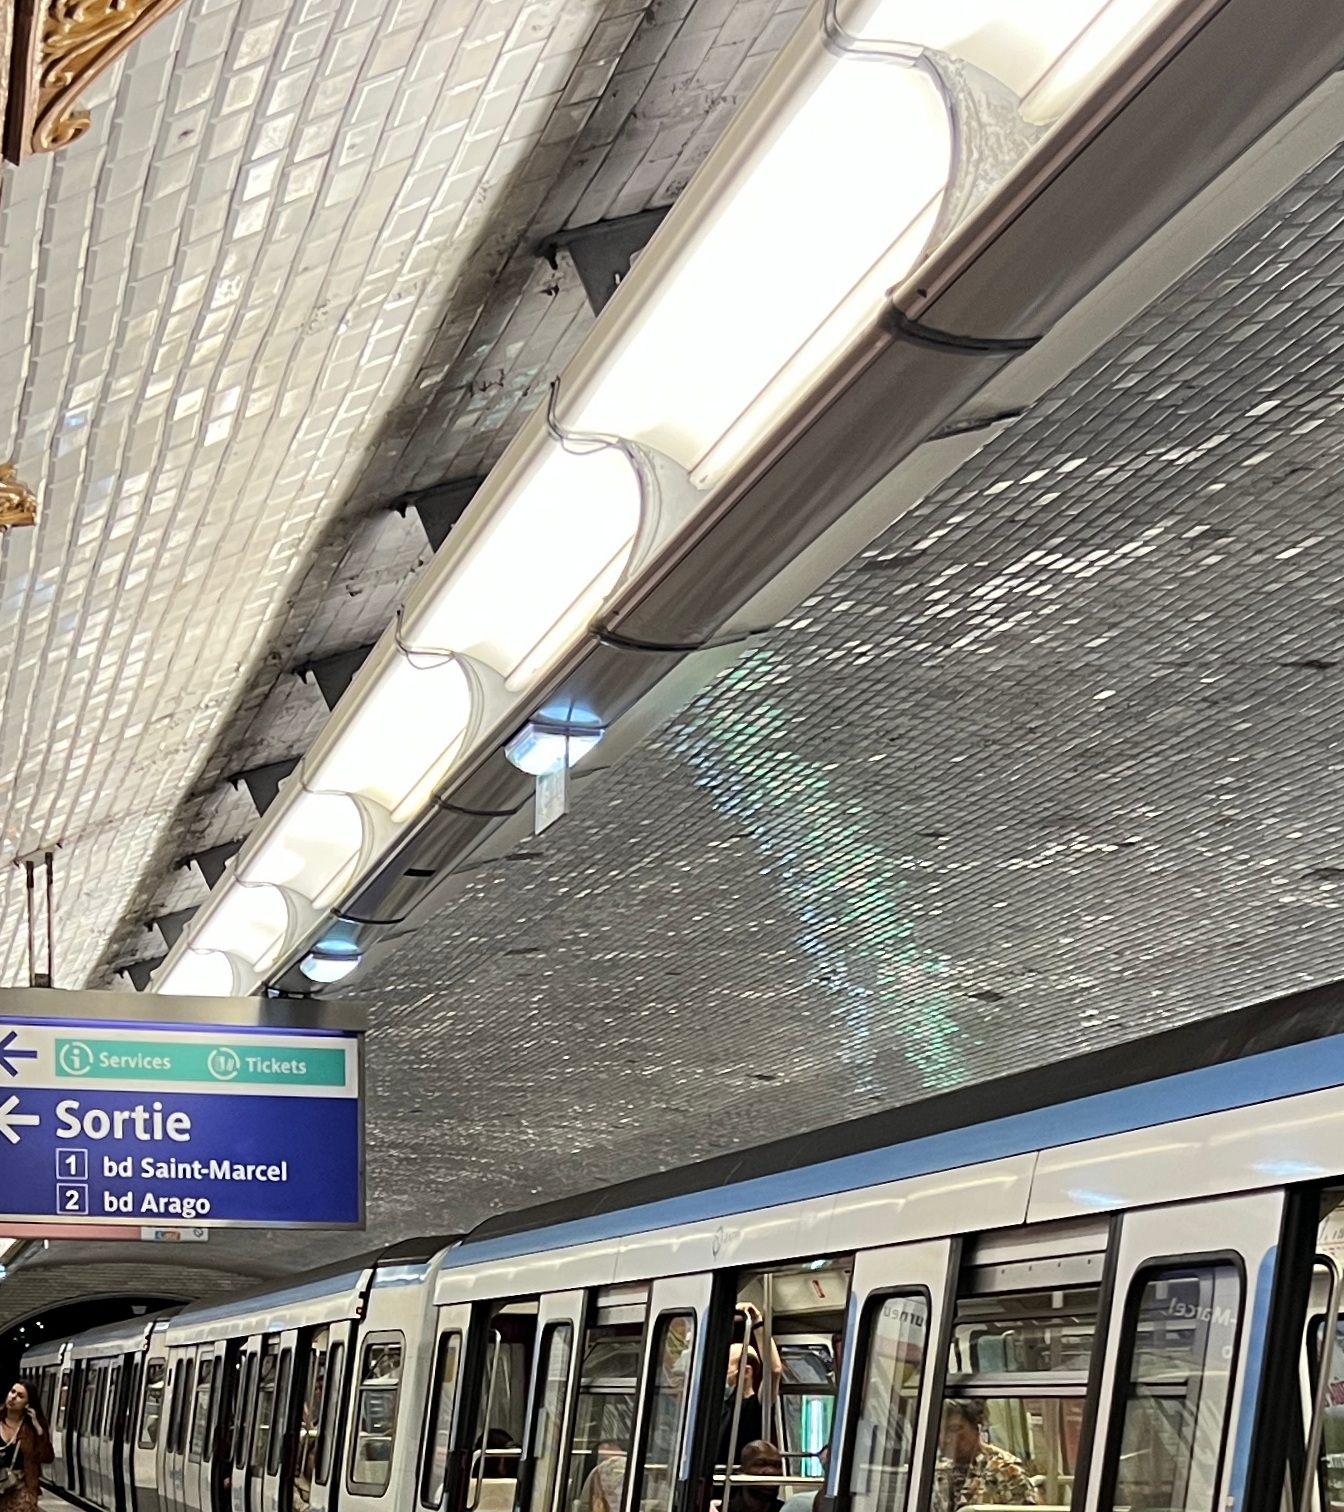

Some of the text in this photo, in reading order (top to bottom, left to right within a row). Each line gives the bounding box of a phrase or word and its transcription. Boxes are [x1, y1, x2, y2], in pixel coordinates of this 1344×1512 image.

[99, 1052, 307, 1075] Services Tickets
[55, 1099, 192, 1142] Sortie
[64, 1154, 288, 1182] 1 bd Saint-Marcel
[64, 1189, 211, 1219] 2 bd Arago
